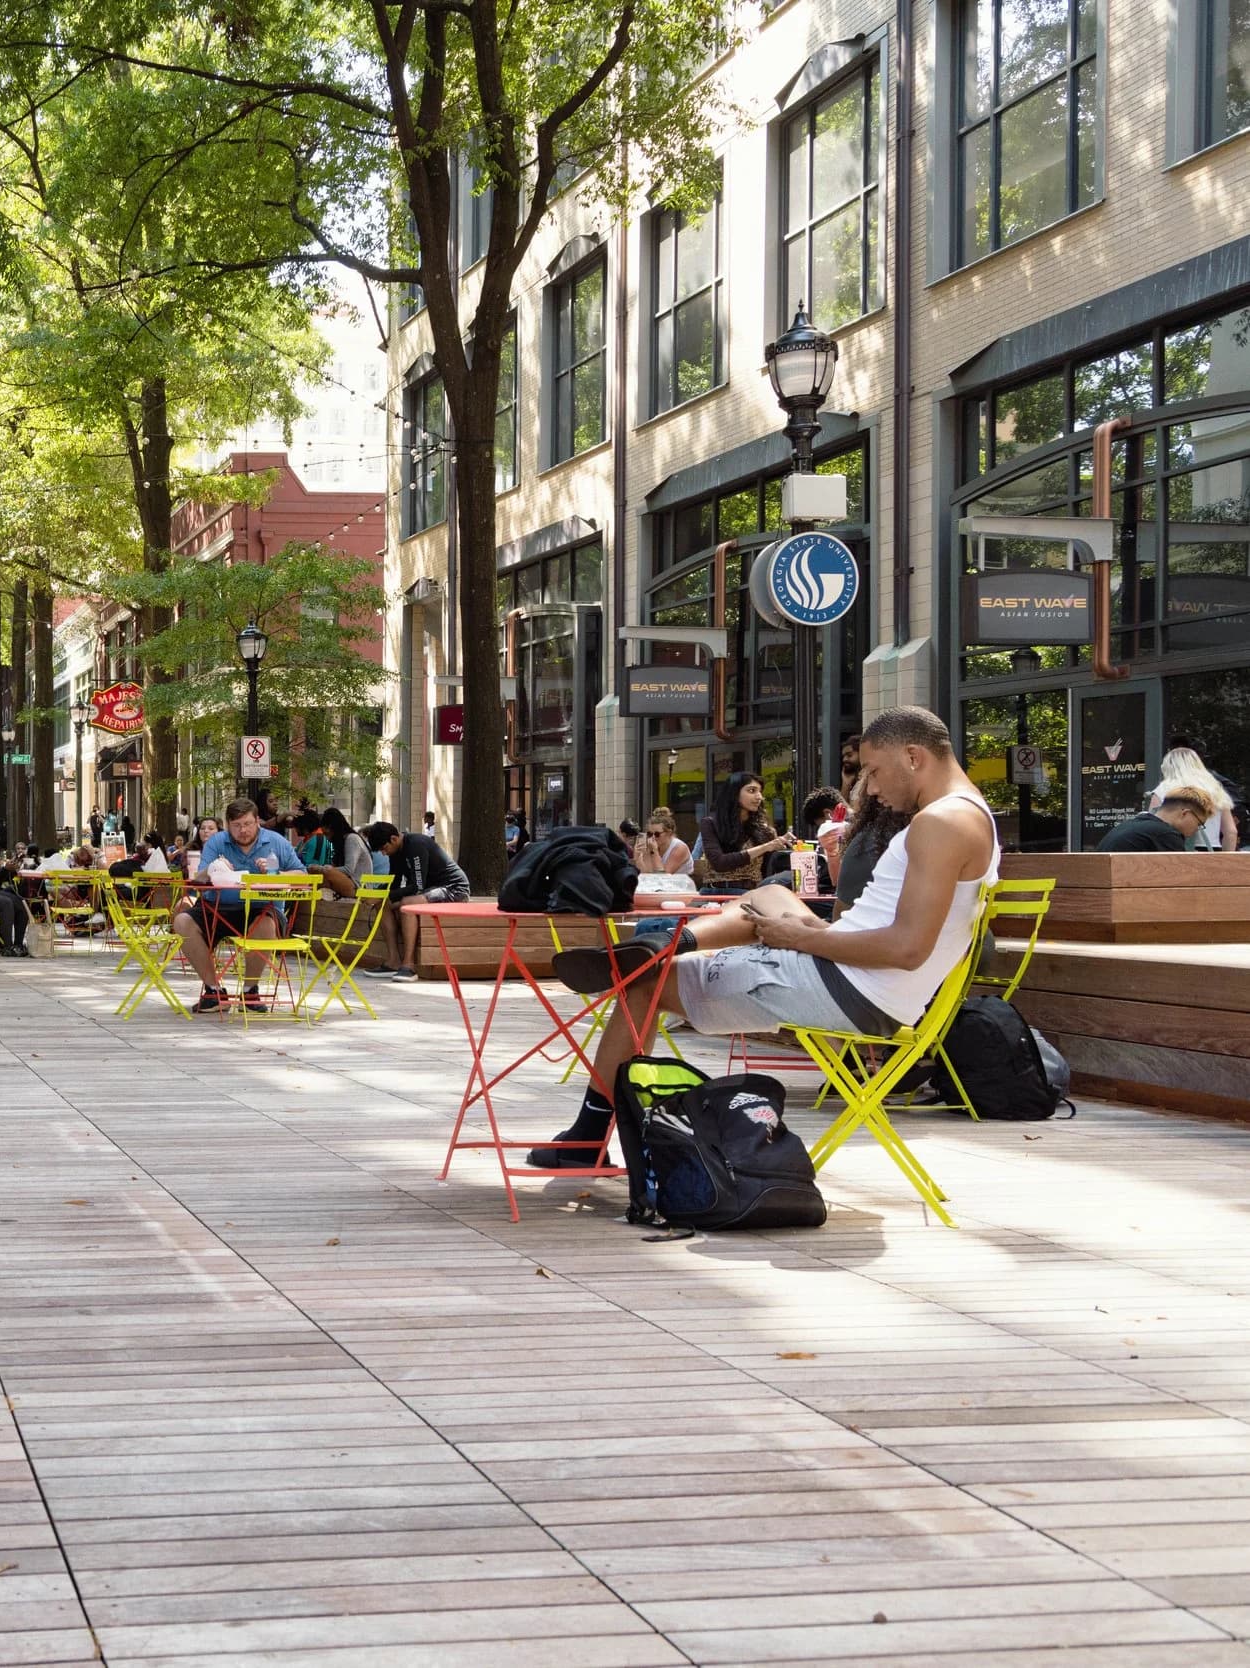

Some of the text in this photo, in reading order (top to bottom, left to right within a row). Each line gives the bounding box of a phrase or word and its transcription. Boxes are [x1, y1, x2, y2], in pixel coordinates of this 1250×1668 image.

[789, 537, 822, 552] STATE
[776, 556, 793, 607] GEORGIA
[828, 542, 855, 607] UNIVERSITY
[979, 596, 1087, 608] EAST WAVE
[631, 682, 708, 692] EAST WAVE
[102, 714, 144, 730] REPAIRIN
[1081, 763, 1147, 775] EAST WAVE
[729, 1096, 769, 1109] adidas
